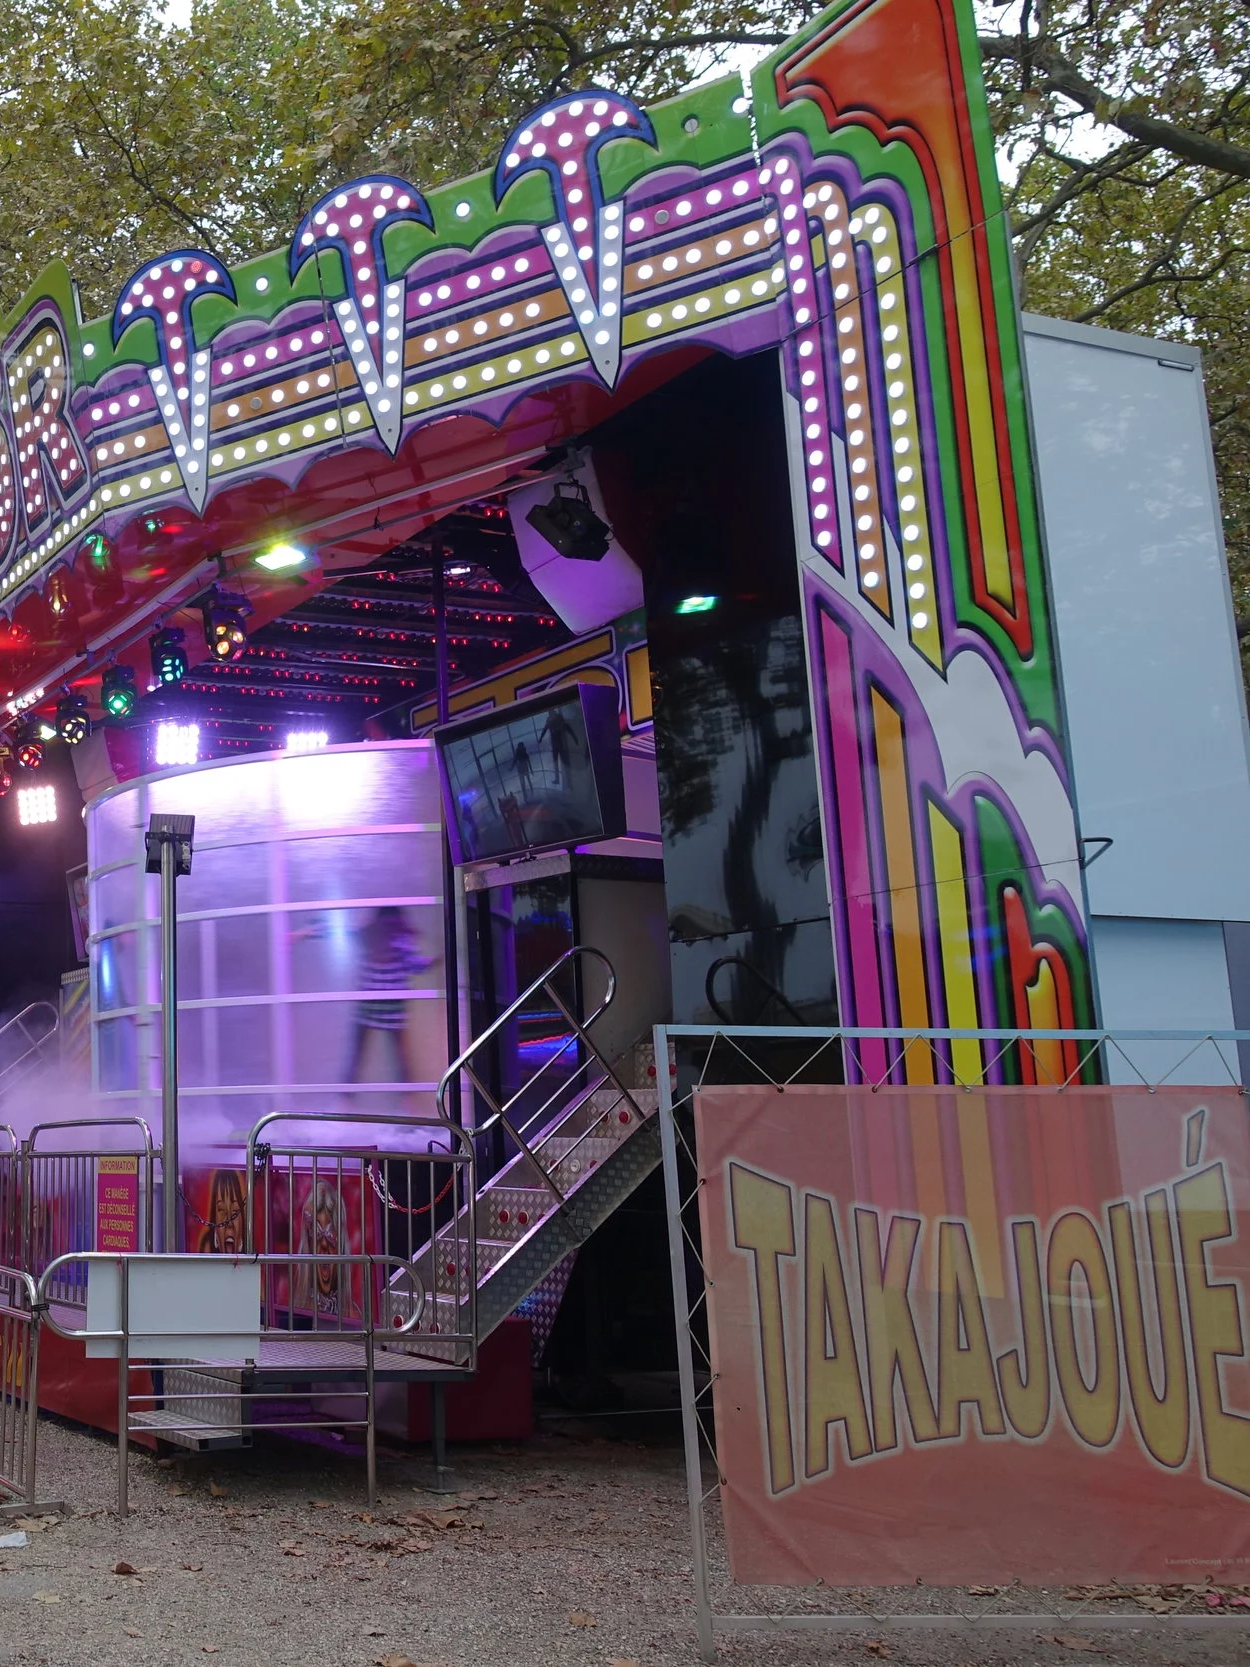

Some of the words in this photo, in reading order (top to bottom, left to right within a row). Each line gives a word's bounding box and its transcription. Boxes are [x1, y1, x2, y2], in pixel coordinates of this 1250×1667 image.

[101, 1160, 135, 1171] INFORMATION
[105, 1188, 111, 1199] CE
[99, 1202, 107, 1214] EST
[100, 1218, 109, 1229] AUX
[109, 1219, 134, 1232] PERSONNES
[729, 1109, 1250, 1501] TAKAJOUÉ
